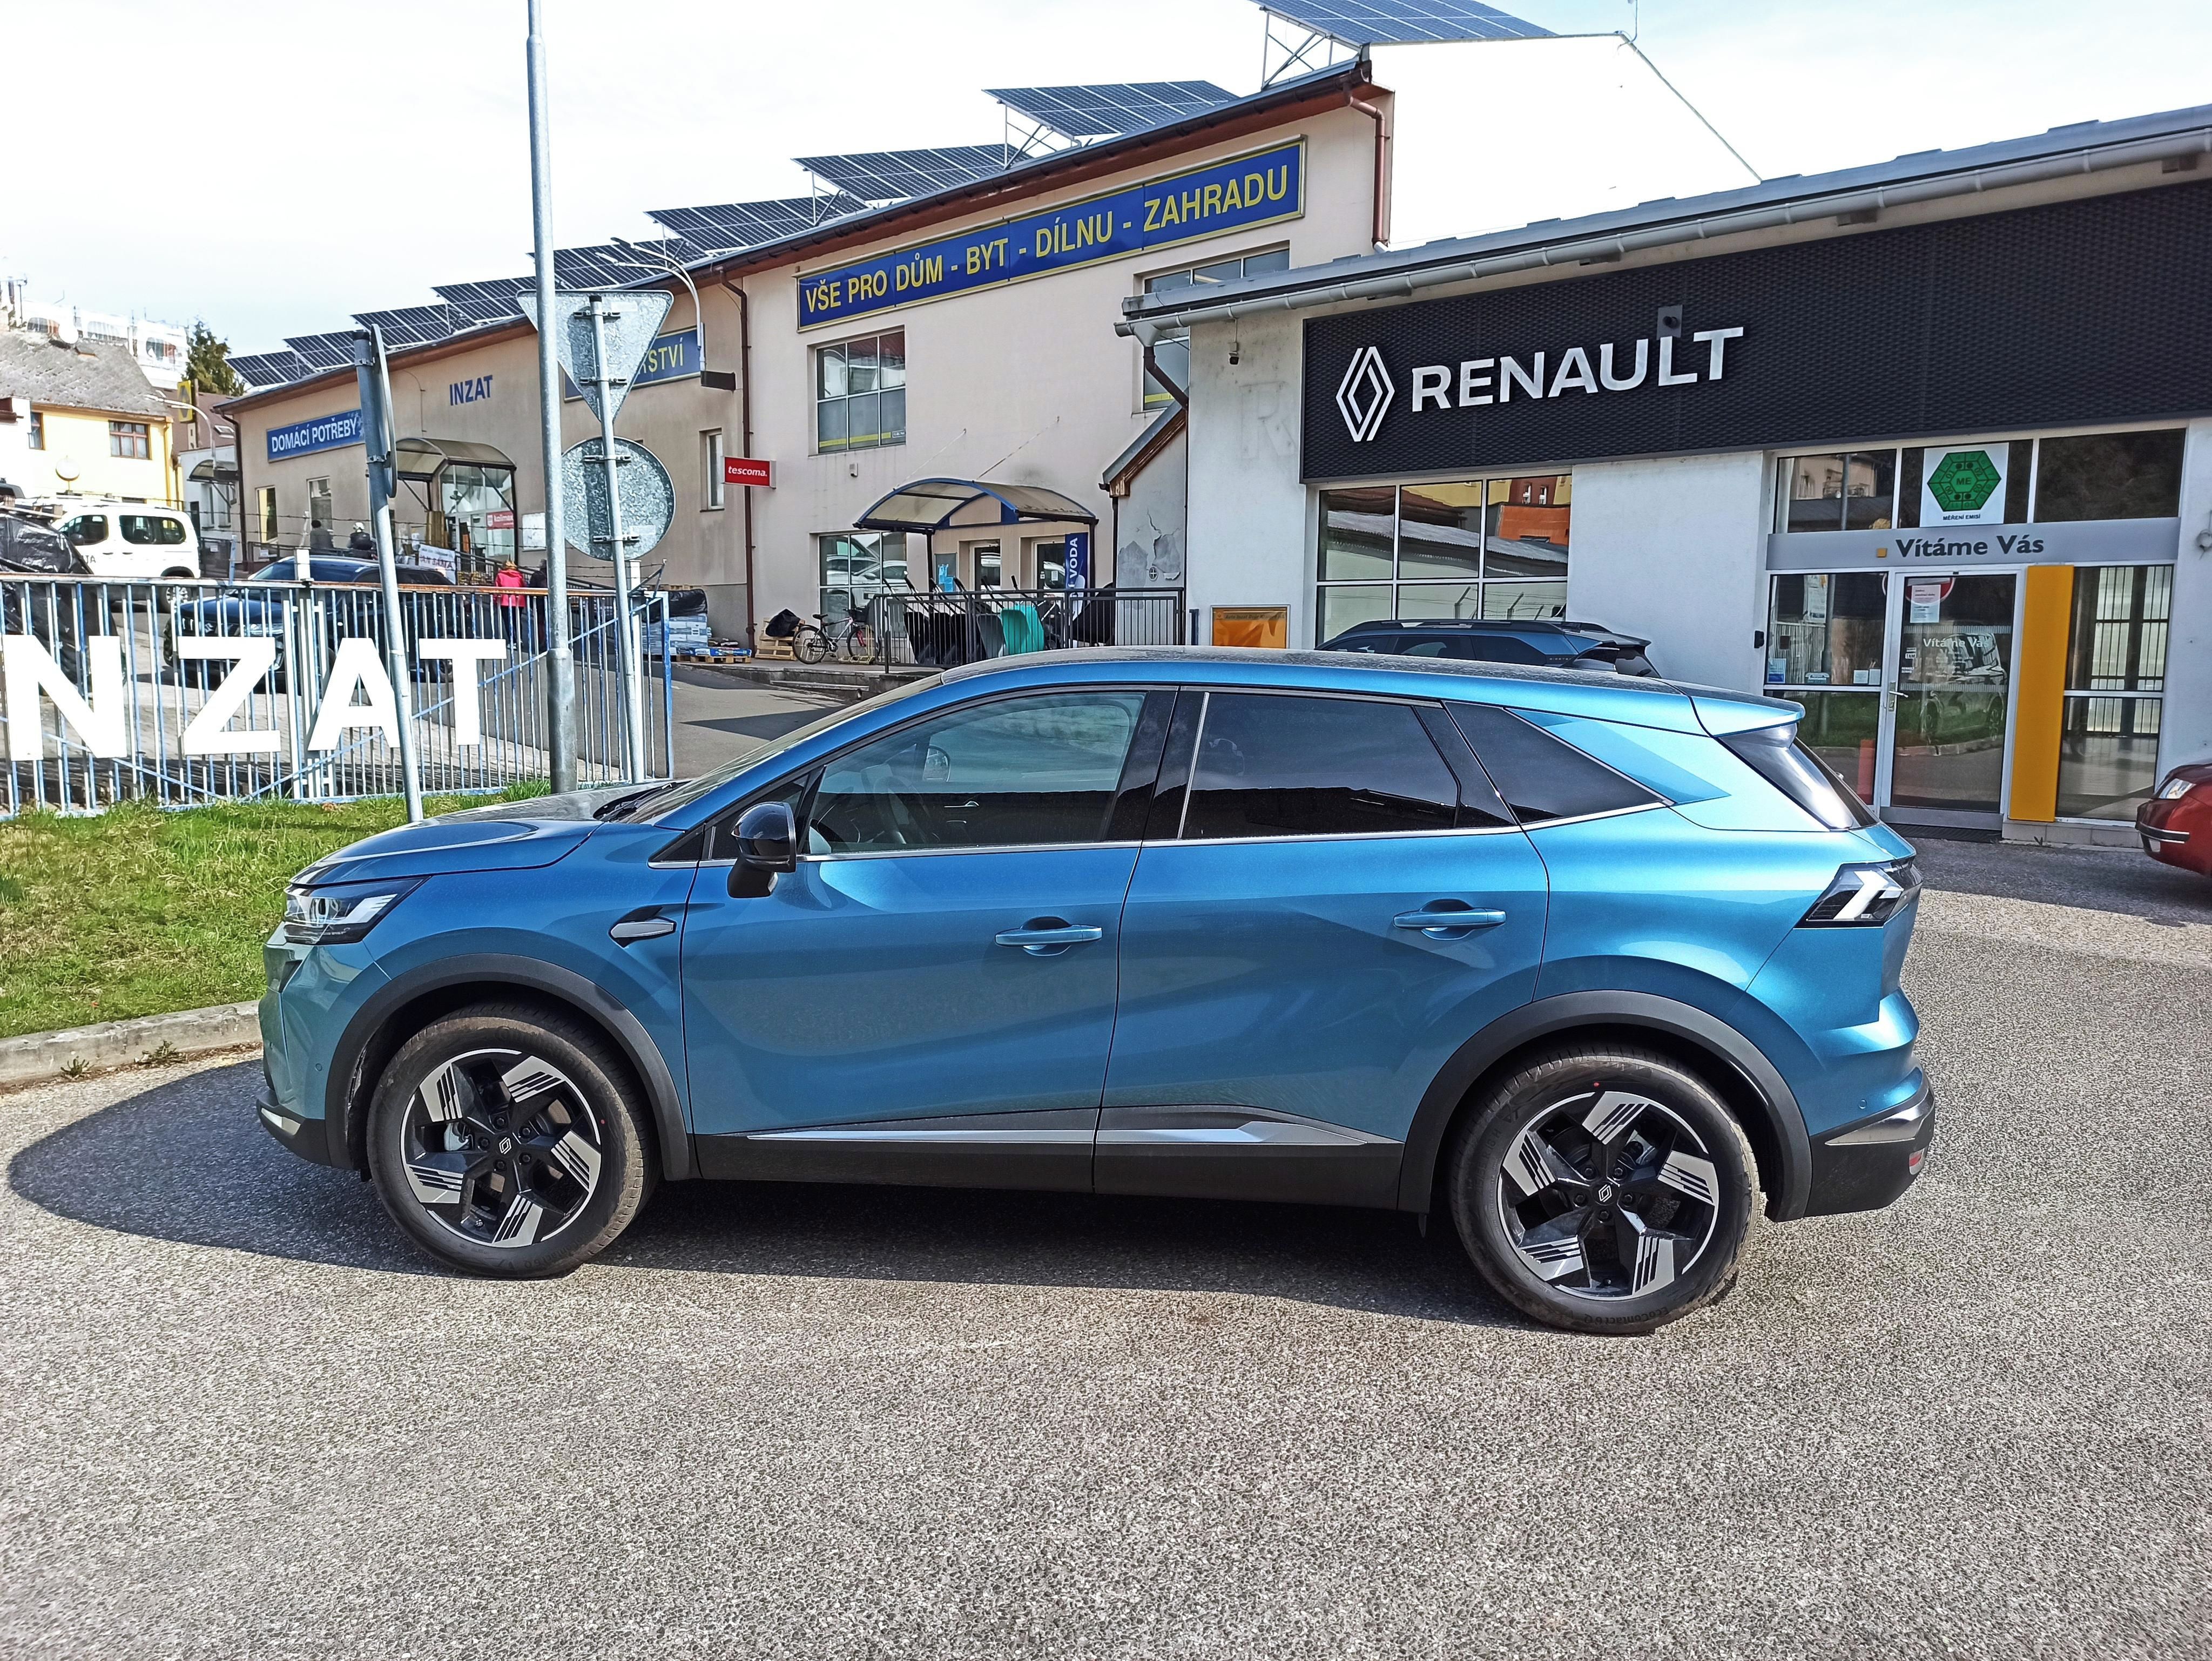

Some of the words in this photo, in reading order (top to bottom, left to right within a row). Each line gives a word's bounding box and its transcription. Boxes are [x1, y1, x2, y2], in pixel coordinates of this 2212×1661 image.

[805, 276, 841, 313] VŠE
[848, 270, 887, 303] PRO
[895, 253, 943, 292] DŮM
[966, 237, 1009, 275] BYT
[1035, 210, 1113, 258] DÍLNU
[1143, 164, 1288, 232] ZAHRADU
[1411, 326, 1744, 413] RENAULT
[449, 374, 493, 406] INZAT
[271, 423, 310, 453] DOMÁCÍ
[312, 416, 358, 444] POTŘEBY
[1069, 537, 1078, 578] VODA
[1896, 537, 1988, 558] Vítáme
[1995, 534, 2045, 555] Vás
